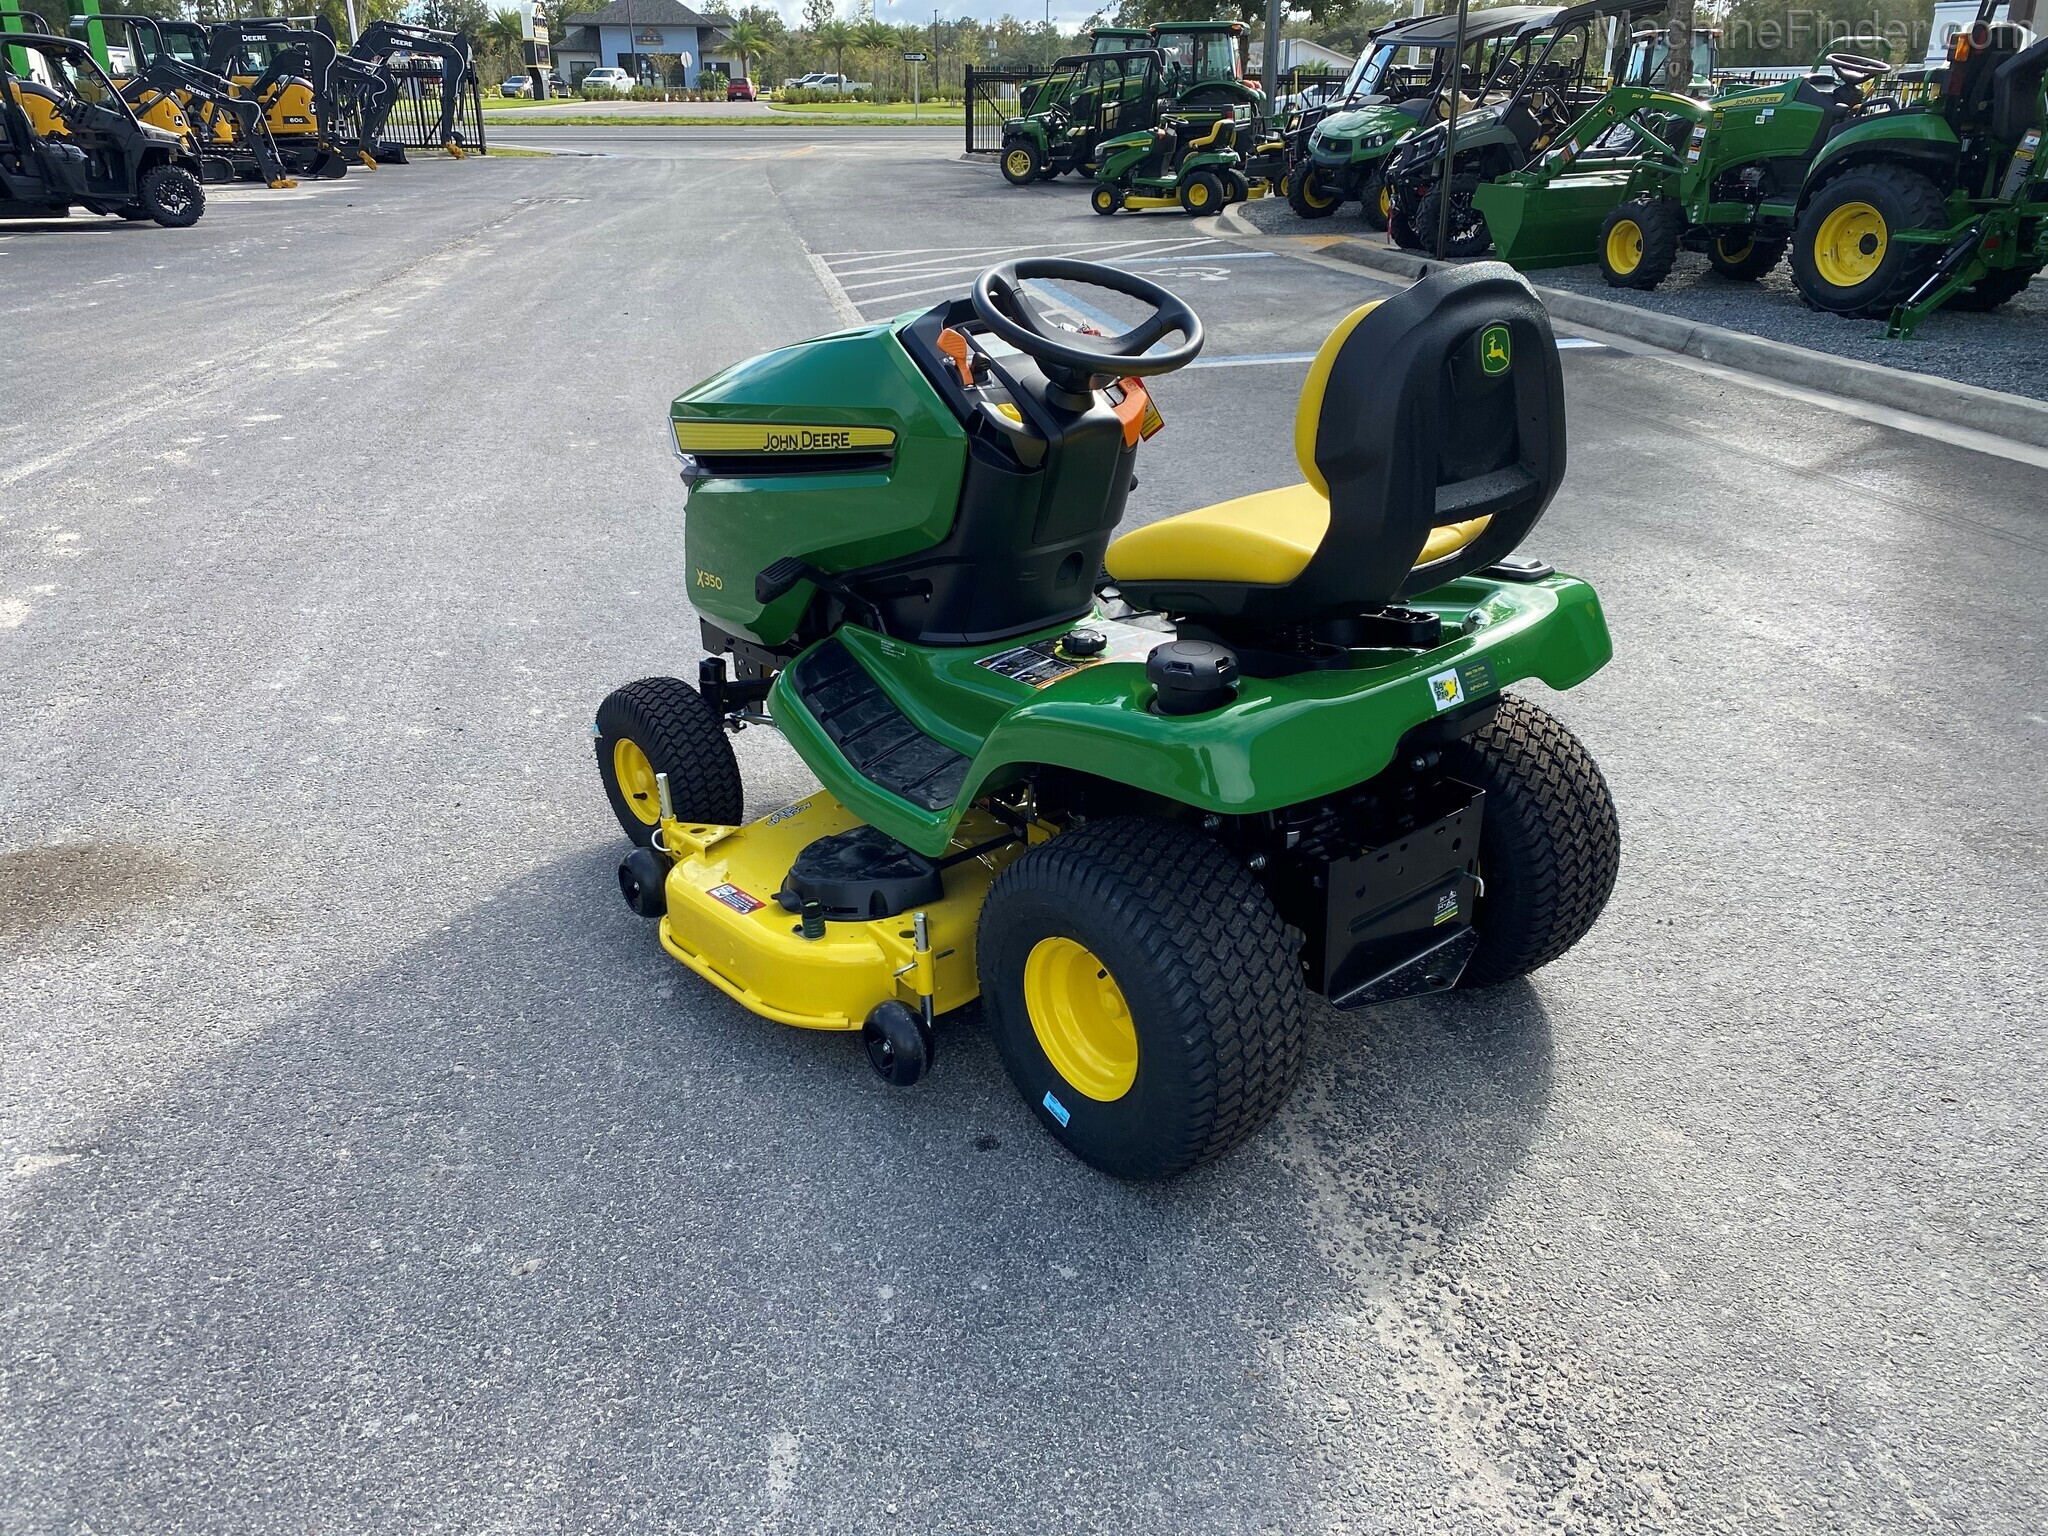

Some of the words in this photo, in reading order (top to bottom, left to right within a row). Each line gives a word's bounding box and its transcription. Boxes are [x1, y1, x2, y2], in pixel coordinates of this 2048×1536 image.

[241, 34, 267, 42] DEERE
[390, 37, 413, 48] DEERE
[185, 83, 211, 99] DEERE
[1754, 96, 1779, 104] DEERE
[763, 432, 799, 451] JOHN
[801, 430, 851, 449] DEERE
[696, 567, 723, 590] X350
